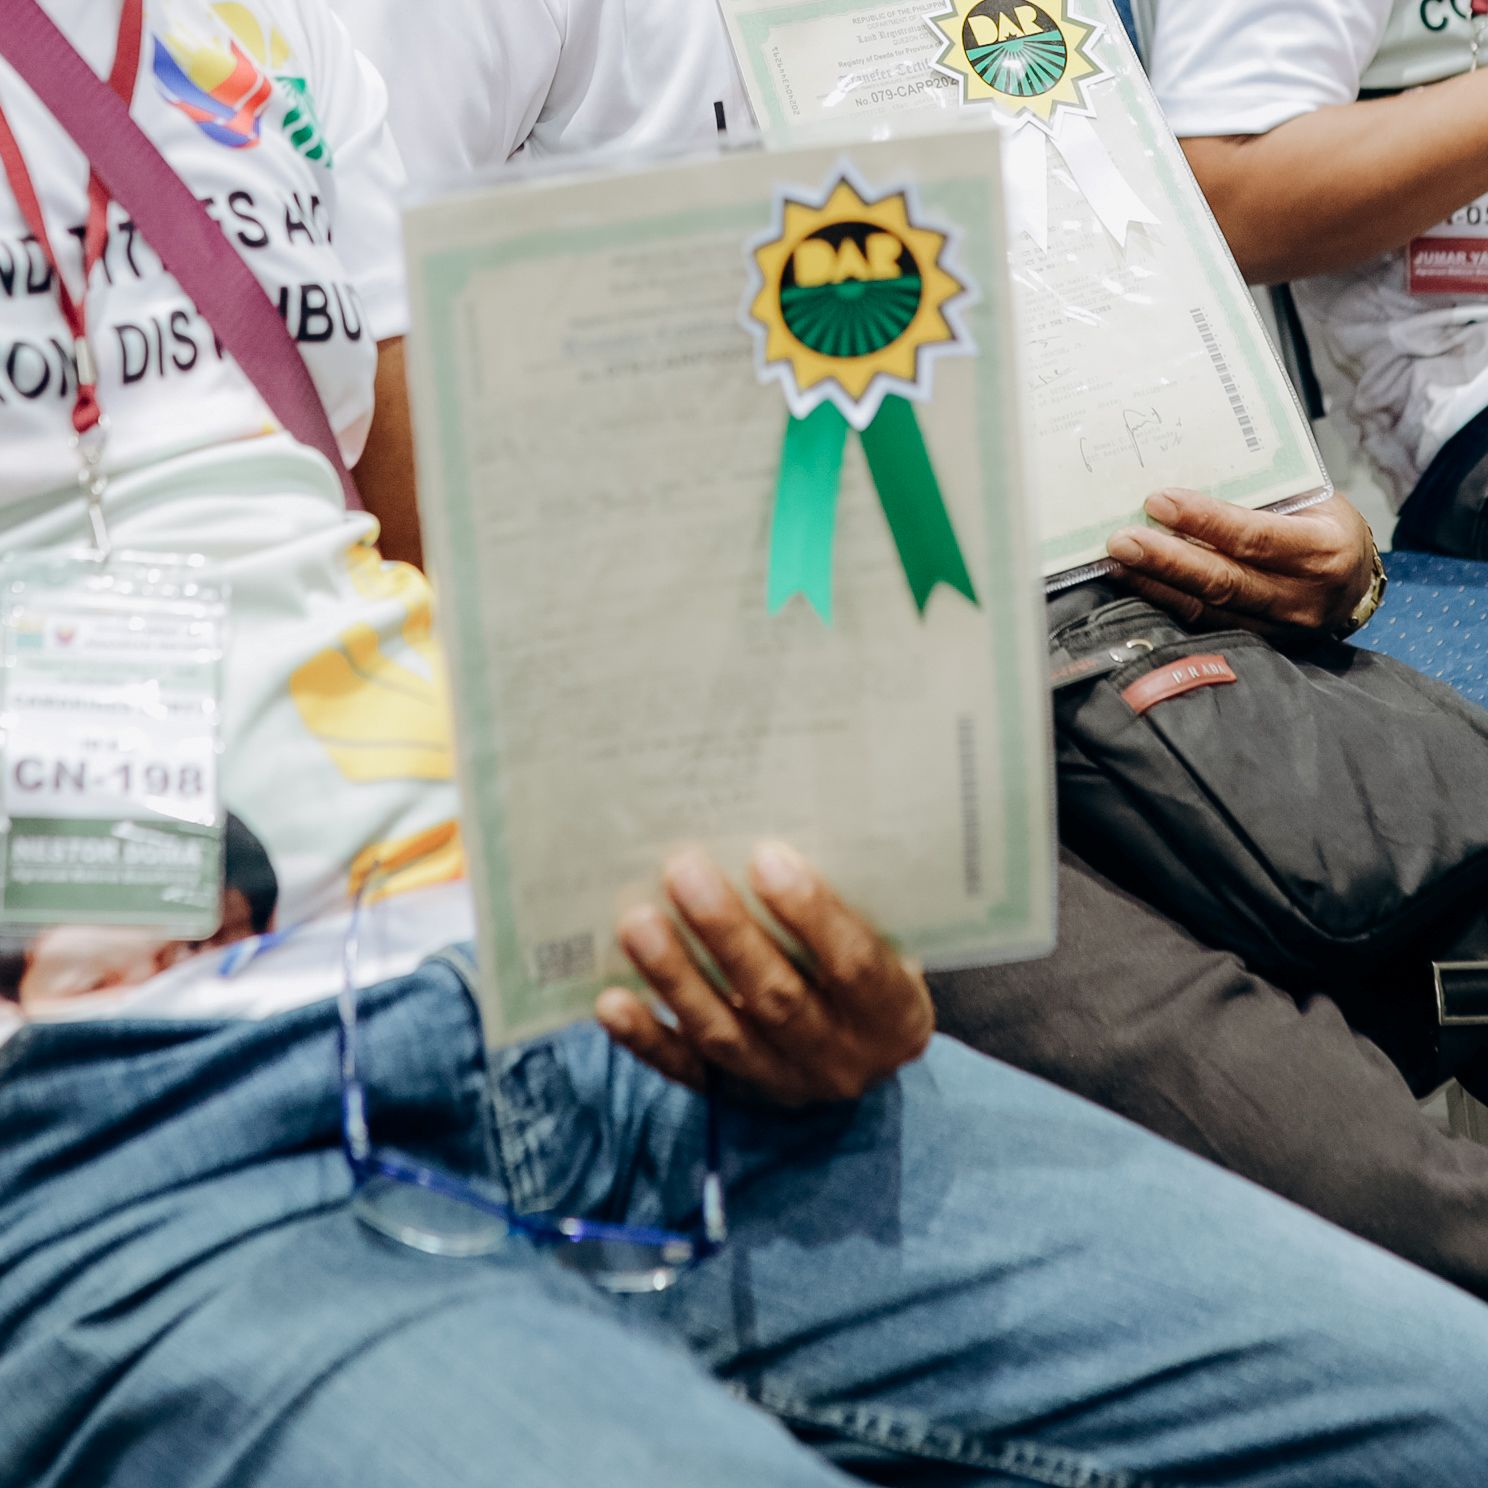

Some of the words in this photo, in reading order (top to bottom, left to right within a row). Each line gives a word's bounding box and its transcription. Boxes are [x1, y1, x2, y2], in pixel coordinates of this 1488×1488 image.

[967, 5, 1044, 47] DAR
[792, 231, 903, 289] DAR
[1171, 663, 1226, 684] PRADA
[14, 758, 204, 797] CN-198
